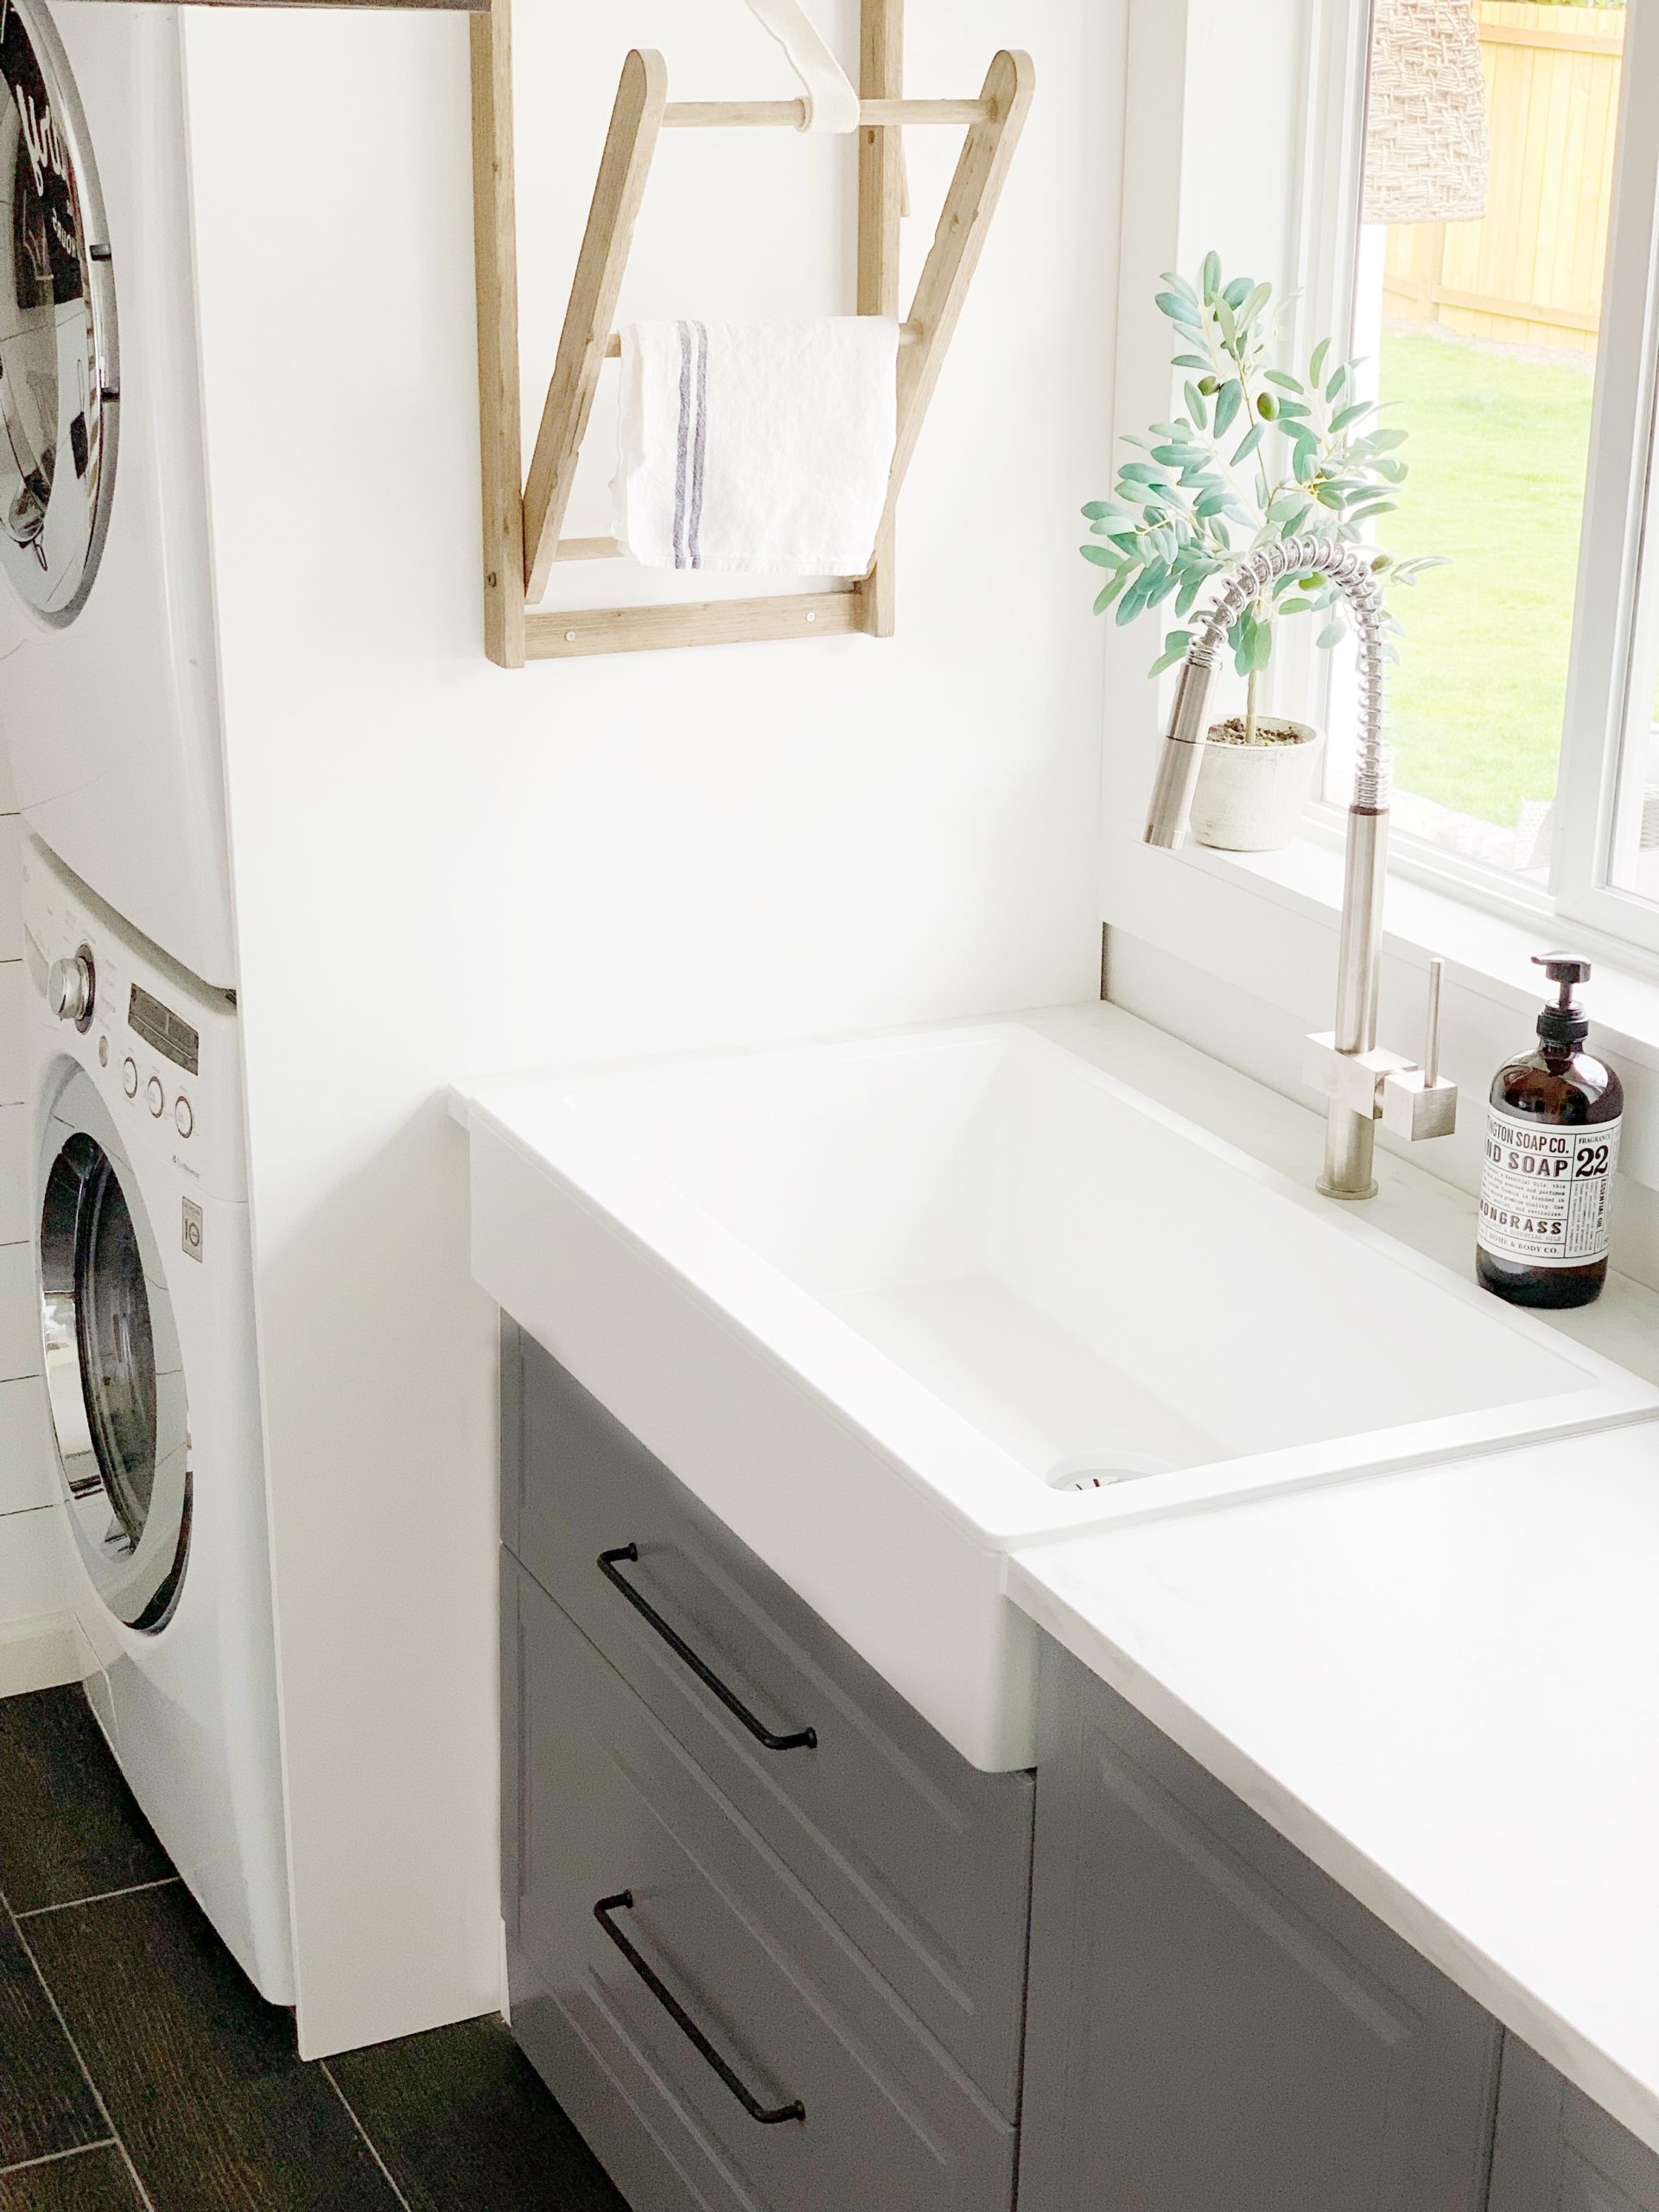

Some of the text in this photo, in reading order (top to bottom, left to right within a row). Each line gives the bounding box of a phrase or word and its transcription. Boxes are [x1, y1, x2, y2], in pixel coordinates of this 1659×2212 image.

[1516, 1131, 1547, 1151] SOAP
[1548, 1137, 1569, 1154] CO.
[1485, 1138, 1568, 1178] ND SOAP
[1575, 1145, 1609, 1178] 22
[1518, 1243, 1542, 1252] BODY
